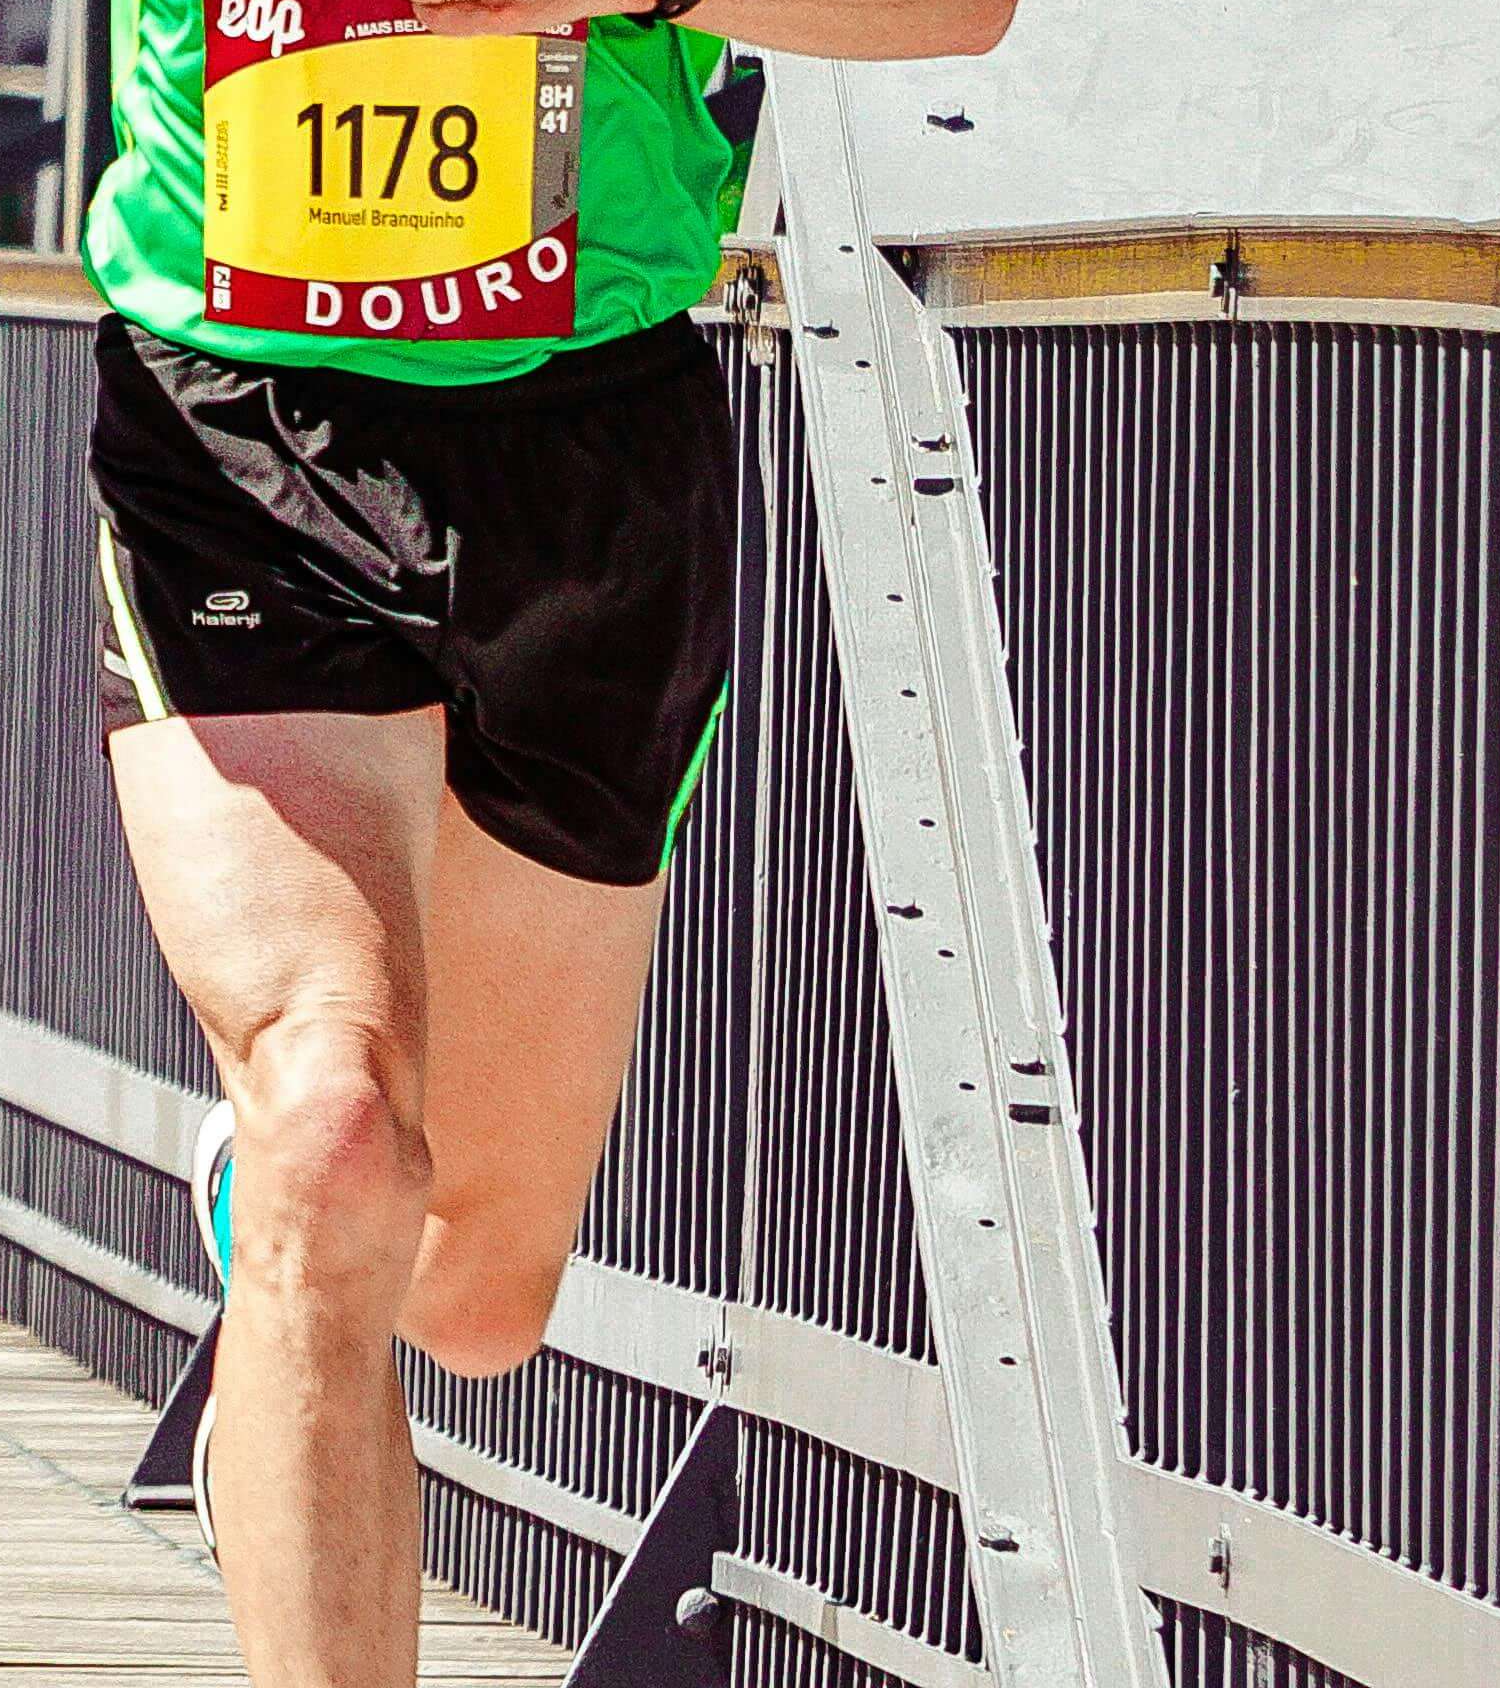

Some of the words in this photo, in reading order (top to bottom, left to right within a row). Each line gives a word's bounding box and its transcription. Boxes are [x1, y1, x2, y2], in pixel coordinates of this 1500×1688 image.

[344, 25, 356, 40] A
[357, 20, 393, 37] MAIS
[393, 18, 429, 33] BEL
[539, 84, 574, 109] 8H
[540, 110, 569, 134] 41
[296, 103, 479, 203] 1178
[308, 207, 367, 226] Manuel
[371, 209, 465, 231] Branquinho
[304, 236, 569, 332] DOURO
